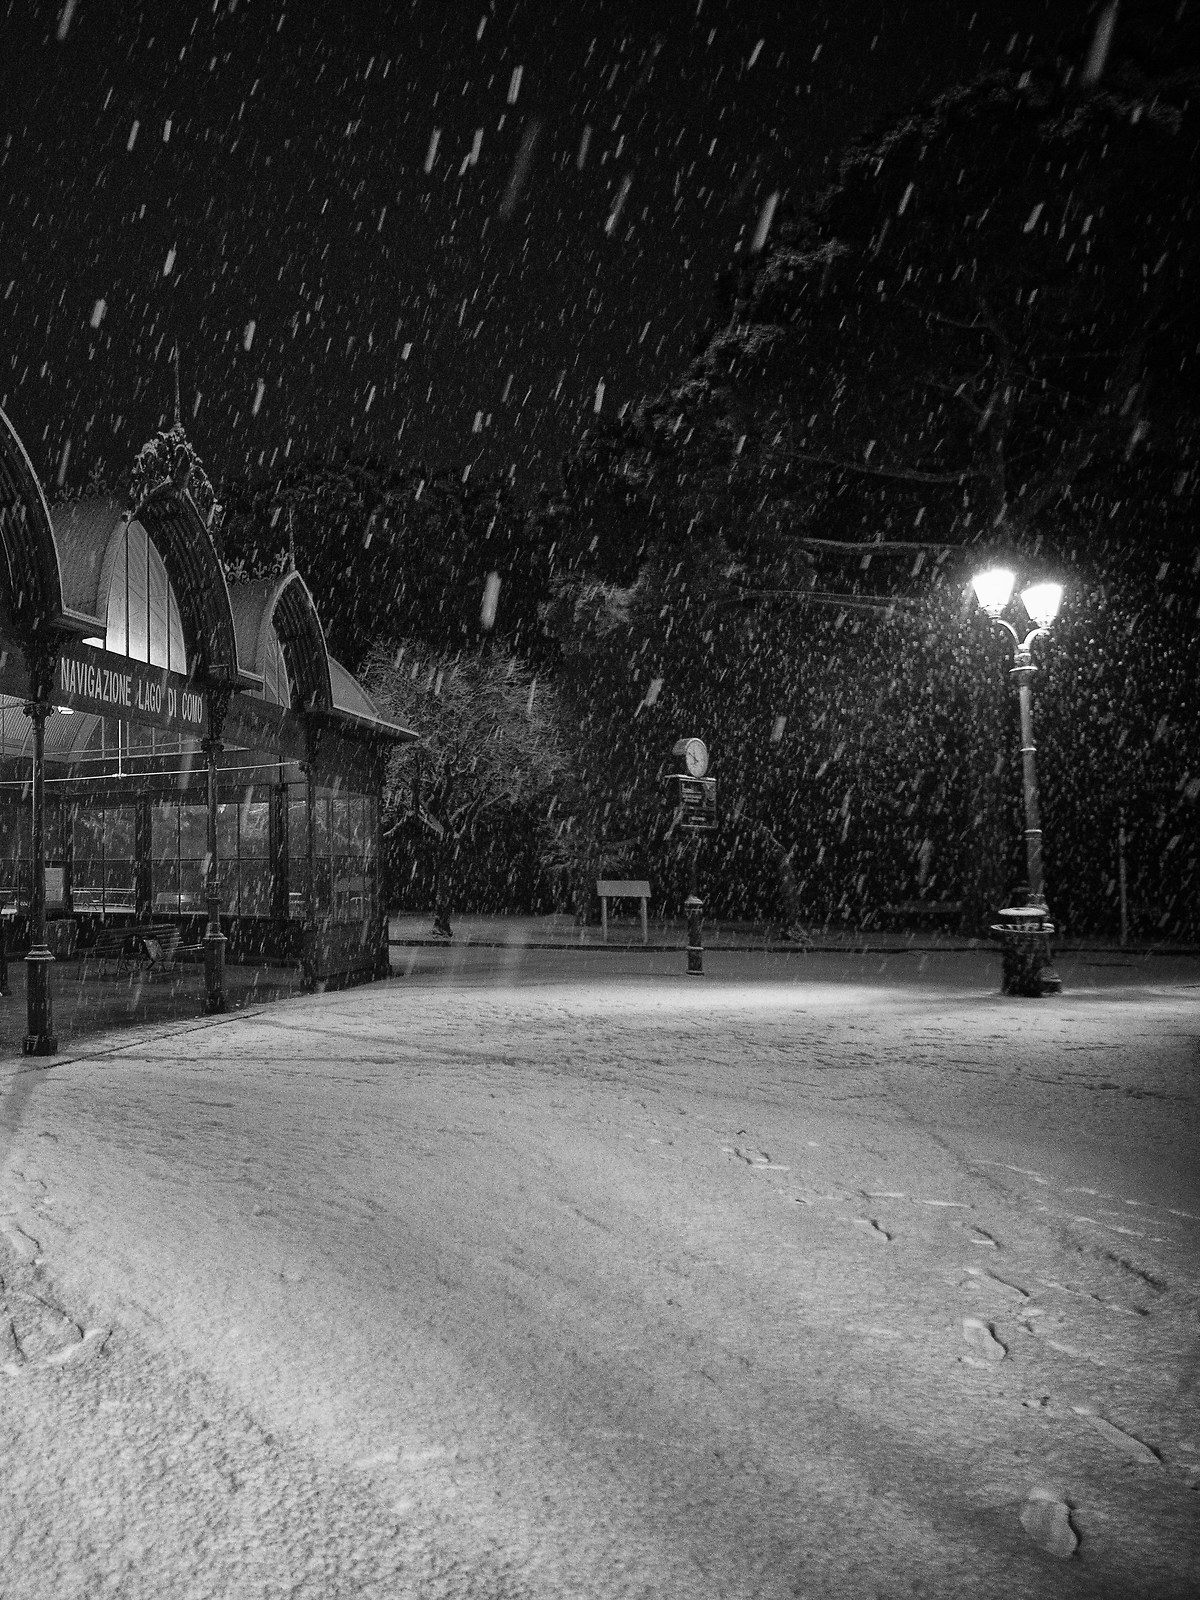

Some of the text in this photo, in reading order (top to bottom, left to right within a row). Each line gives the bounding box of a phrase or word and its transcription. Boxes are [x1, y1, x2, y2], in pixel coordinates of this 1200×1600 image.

[61, 656, 203, 724] NAVIGAZIONE LAGO DI COMO
